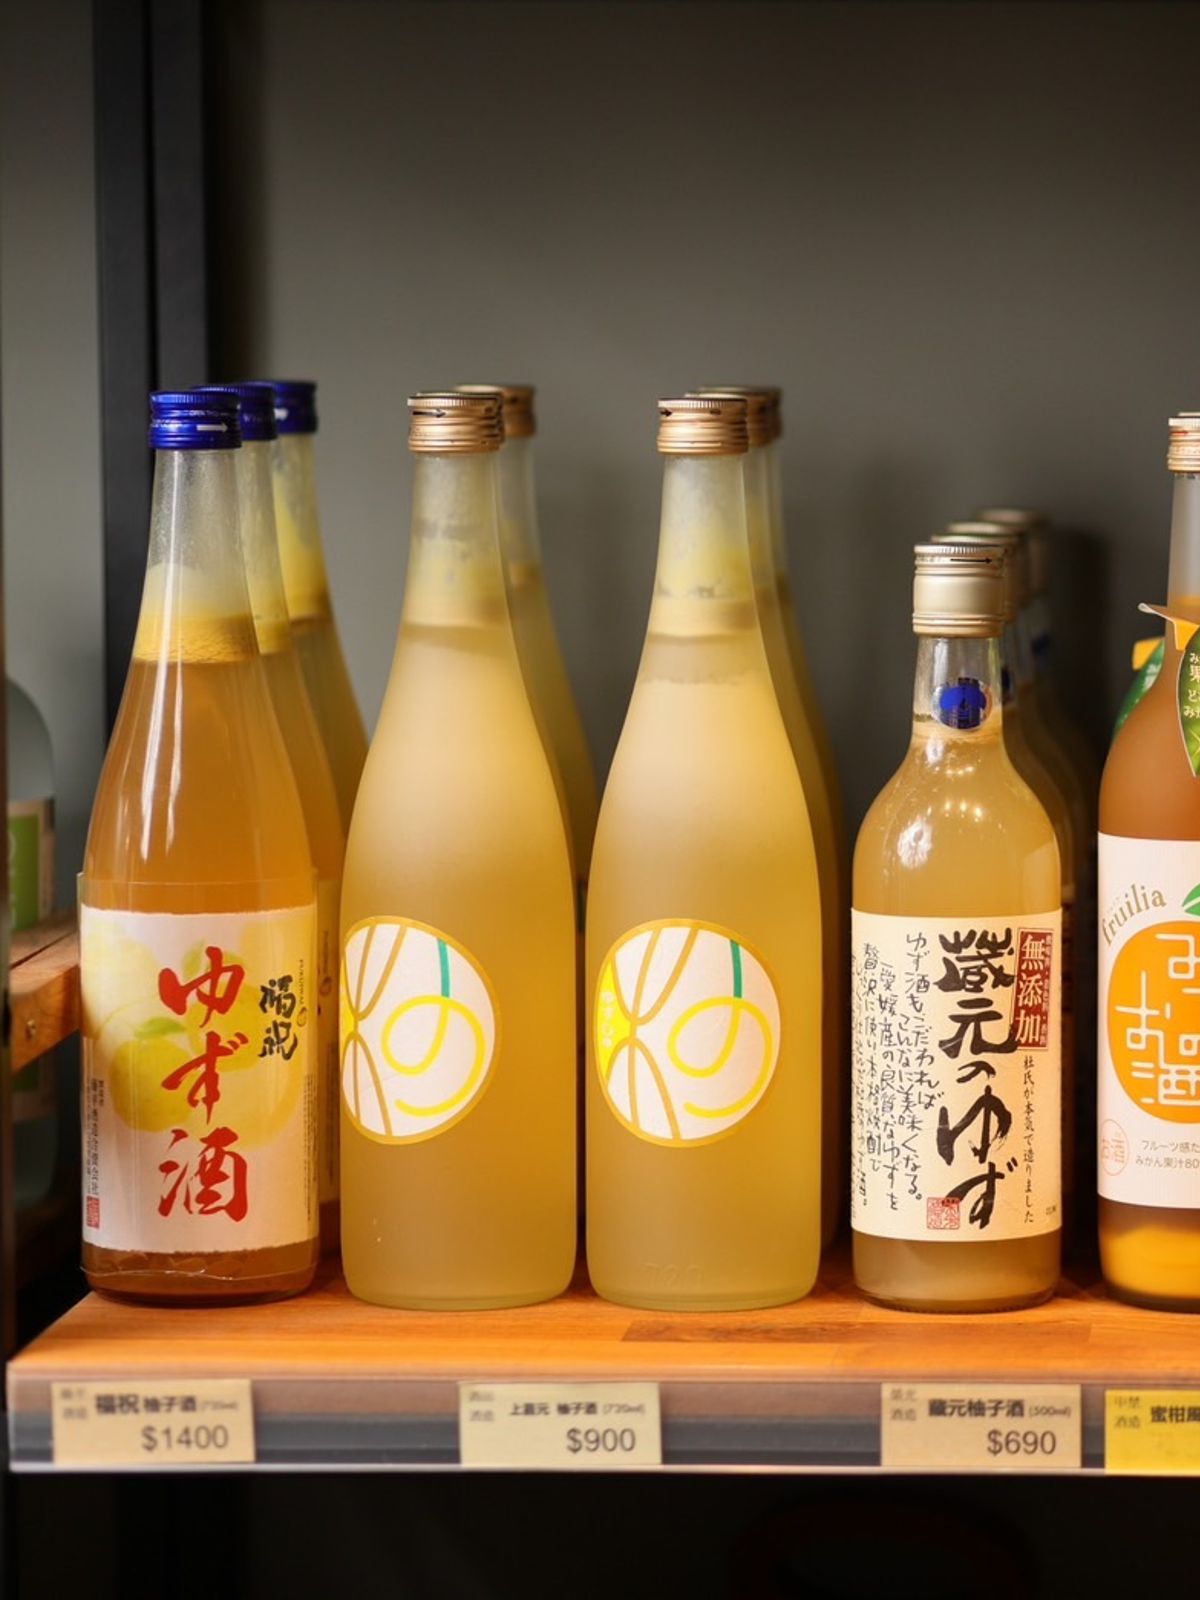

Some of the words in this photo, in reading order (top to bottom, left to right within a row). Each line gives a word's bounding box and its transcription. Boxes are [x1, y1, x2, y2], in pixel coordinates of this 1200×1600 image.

[1014, 933, 1046, 1045] 無添加
[157, 945, 249, 1223] ゆず酒
[142, 1425, 229, 1453] $1400
[566, 1428, 636, 1454] $900
[986, 1429, 1057, 1456] $690
